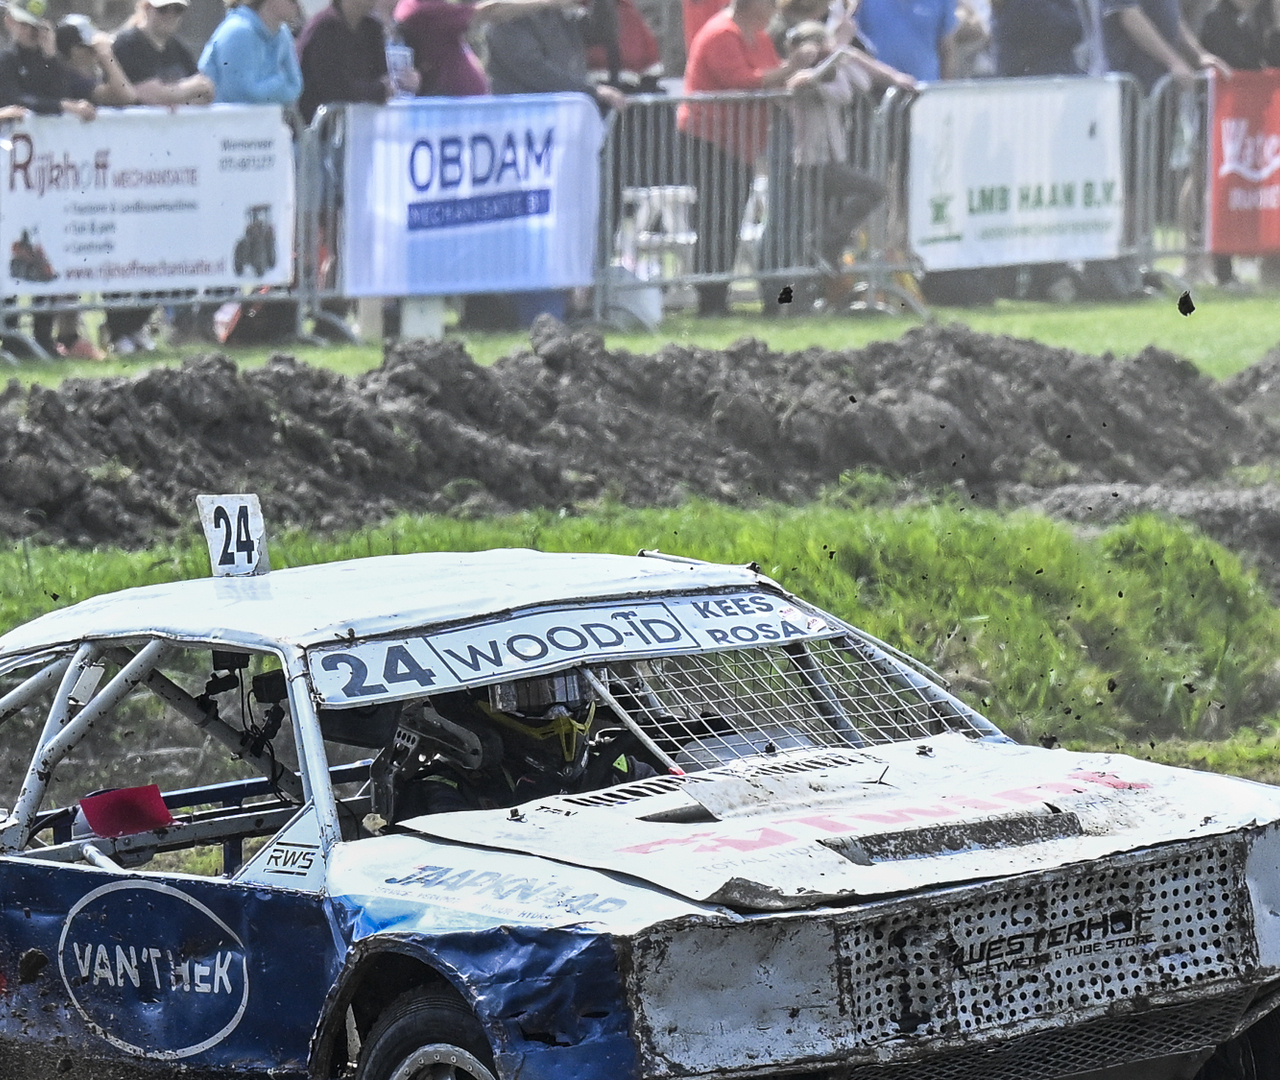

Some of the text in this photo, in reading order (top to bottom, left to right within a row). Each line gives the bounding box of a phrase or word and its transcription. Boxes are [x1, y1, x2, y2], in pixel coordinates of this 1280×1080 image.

[8, 133, 111, 197] Rijkhoff
[409, 127, 556, 192] OBDAM
[967, 186, 1009, 215] LMB
[1018, 182, 1076, 211] HAAN
[213, 505, 255, 566] 24
[690, 596, 774, 619] KEES
[705, 620, 808, 645] ROSA
[320, 644, 435, 699] 24
[267, 849, 316, 869] RWS
[1065, 941, 1103, 958] TUBE
[1106, 933, 1157, 950] STORE
